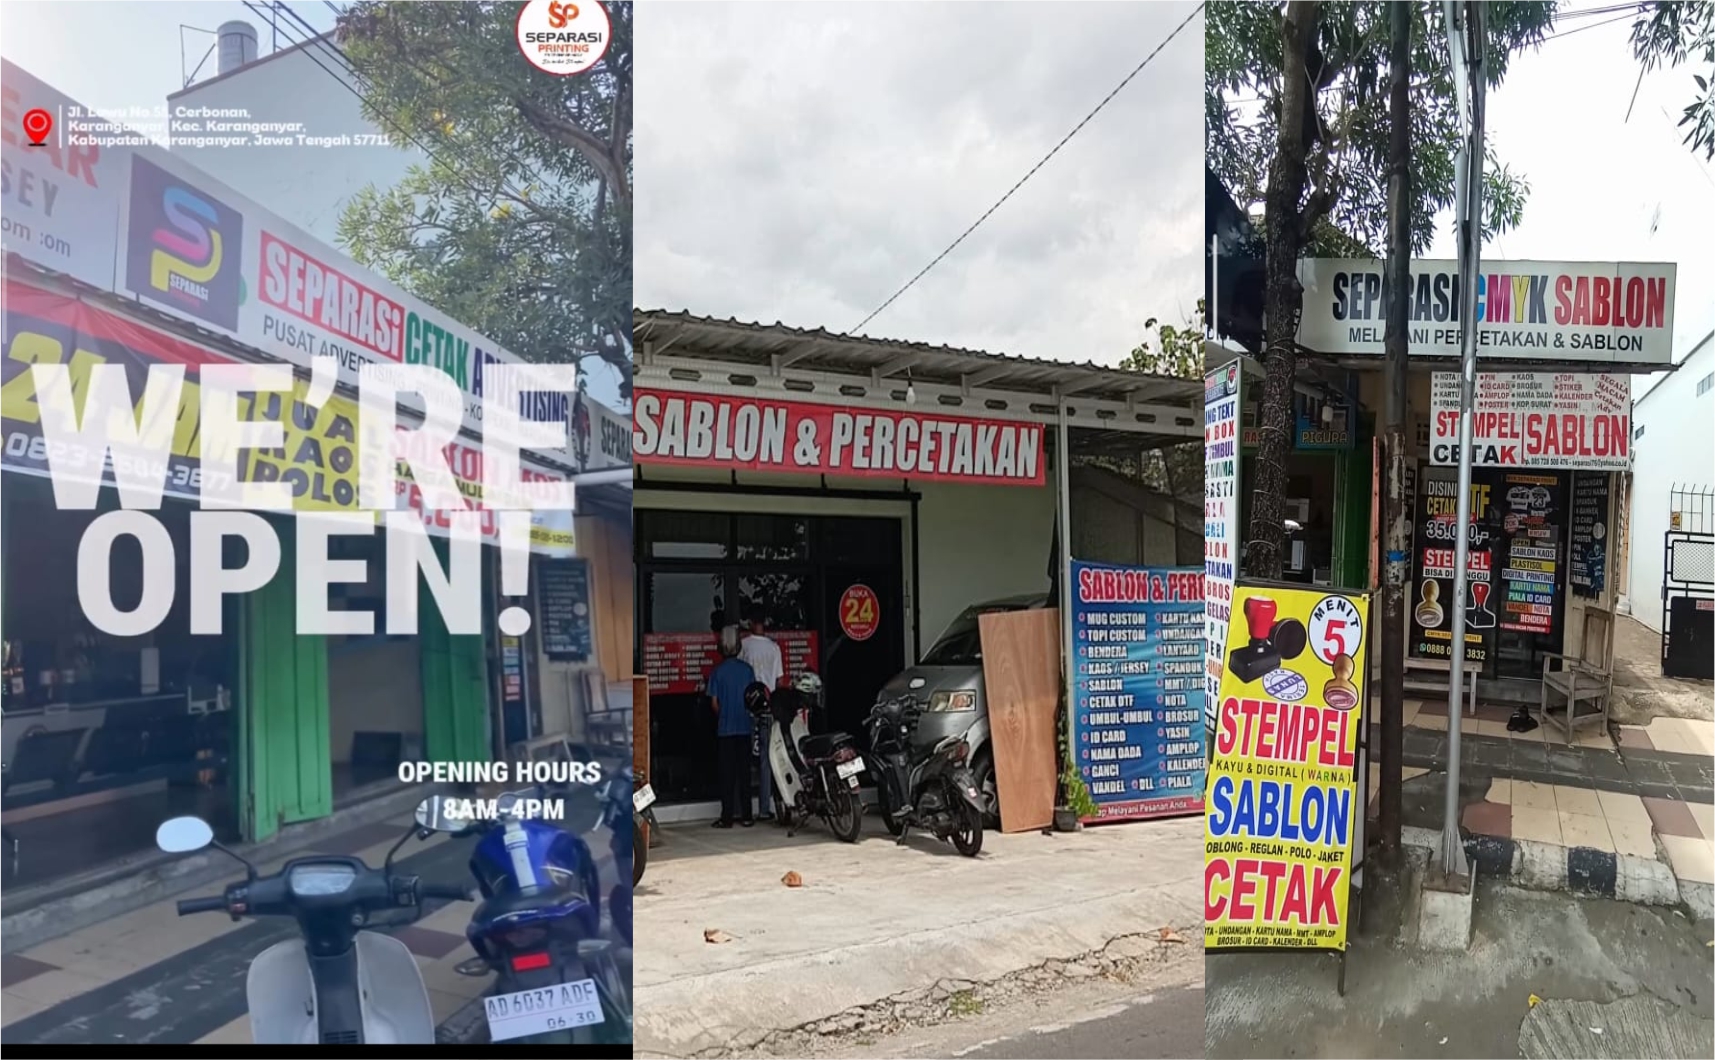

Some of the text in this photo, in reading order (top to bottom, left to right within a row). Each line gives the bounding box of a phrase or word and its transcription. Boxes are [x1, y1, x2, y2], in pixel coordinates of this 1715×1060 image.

[1554, 274, 1666, 328] SABLON
[263, 314, 316, 351] PUSAT
[1434, 329, 1548, 348] PERETAKAN
[1553, 333, 1565, 348] &
[1571, 333, 1643, 352] SABLON
[405, 310, 469, 391] CETAK
[1560, 374, 1574, 382] TOPI
[1601, 373, 1628, 395] SEGALA
[1516, 382, 1543, 390] BROSUR
[1560, 383, 1583, 391] STIKER
[1598, 381, 1625, 402] MACAM
[1217, 401, 1235, 421] TEXT
[1214, 420, 1235, 440] BOX
[1436, 410, 1520, 440] STMPEL
[633, 394, 787, 463] SABLON
[793, 418, 820, 468] &
[829, 411, 1041, 478] PERCETAKAN
[1302, 430, 1348, 444] PIGURA
[1527, 413, 1628, 457] SABLON
[1428, 481, 1457, 497] DISINI
[1426, 484, 1491, 519] CETAK TF
[1533, 496, 1545, 507] 23
[1512, 547, 1554, 558] SABLON KAOS
[1511, 559, 1543, 569] PLASTISOL
[1425, 567, 1443, 577] BISA
[1502, 568, 1524, 579] DIGITAL
[1526, 571, 1554, 582] PRINTING
[1079, 568, 1148, 602] SABLON
[1151, 575, 1166, 602] &
[1207, 580, 1230, 600] BROS
[1509, 581, 1550, 593] KARTU NAMA
[1508, 591, 1526, 602] PIALA
[1534, 595, 1551, 604] CARD
[845, 598, 874, 623] 24
[1207, 600, 1230, 624] GELAS
[1314, 599, 1359, 628] MENIT
[1087, 612, 1146, 625] MUG CUSTOM
[1162, 612, 1189, 624] KARTU
[1520, 614, 1548, 625] BENDERA
[1088, 630, 1146, 642] TOPI CUSTOM
[1323, 619, 1347, 662] 5
[1088, 646, 1127, 658] BENDERA
[1163, 645, 1199, 656] LANYARD
[1426, 643, 1445, 655] 0888
[1466, 648, 1486, 660] 3832
[1088, 662, 1149, 674] KAOS JERSEY
[1164, 662, 1203, 674] SPANDUK
[1089, 679, 1123, 691] SABLON
[1165, 679, 1184, 690] MMT
[1089, 695, 1134, 708] CETAK DTF
[1165, 695, 1186, 706] NOTA
[1089, 710, 1153, 725] UMBUL-UMBUL
[1165, 710, 1199, 722] BROSUR
[1090, 730, 1126, 743] ID CARD
[1166, 727, 1190, 739] YASIN
[1218, 698, 1354, 768] STEMPEL
[1090, 746, 1142, 760] NAMA DADA
[1166, 743, 1200, 755] AMPLOP
[1092, 764, 1119, 777] GANCI
[1216, 759, 1298, 779] KAYU & DIGITAL
[1093, 780, 1125, 794] VANDEL
[1139, 779, 1154, 790] DLL
[1168, 776, 1192, 788] PIALA
[1108, 804, 1139, 817] Melayani
[1169, 800, 1187, 809] Anda
[1209, 776, 1350, 846] SABLON
[1206, 842, 1344, 863] OBLONG REGLAN POLO JAKET
[1205, 858, 1342, 926] CETAK
[1218, 926, 1251, 935] UNDANGAN
[1255, 927, 1275, 936] KARTU
[1275, 928, 1292, 936] NAMA
[1313, 929, 1336, 938] AMPLOP
[1217, 936, 1318, 946] BROSUR ID CARD KALENDER DLL
[487, 981, 594, 1019] AD 6037 ADF
